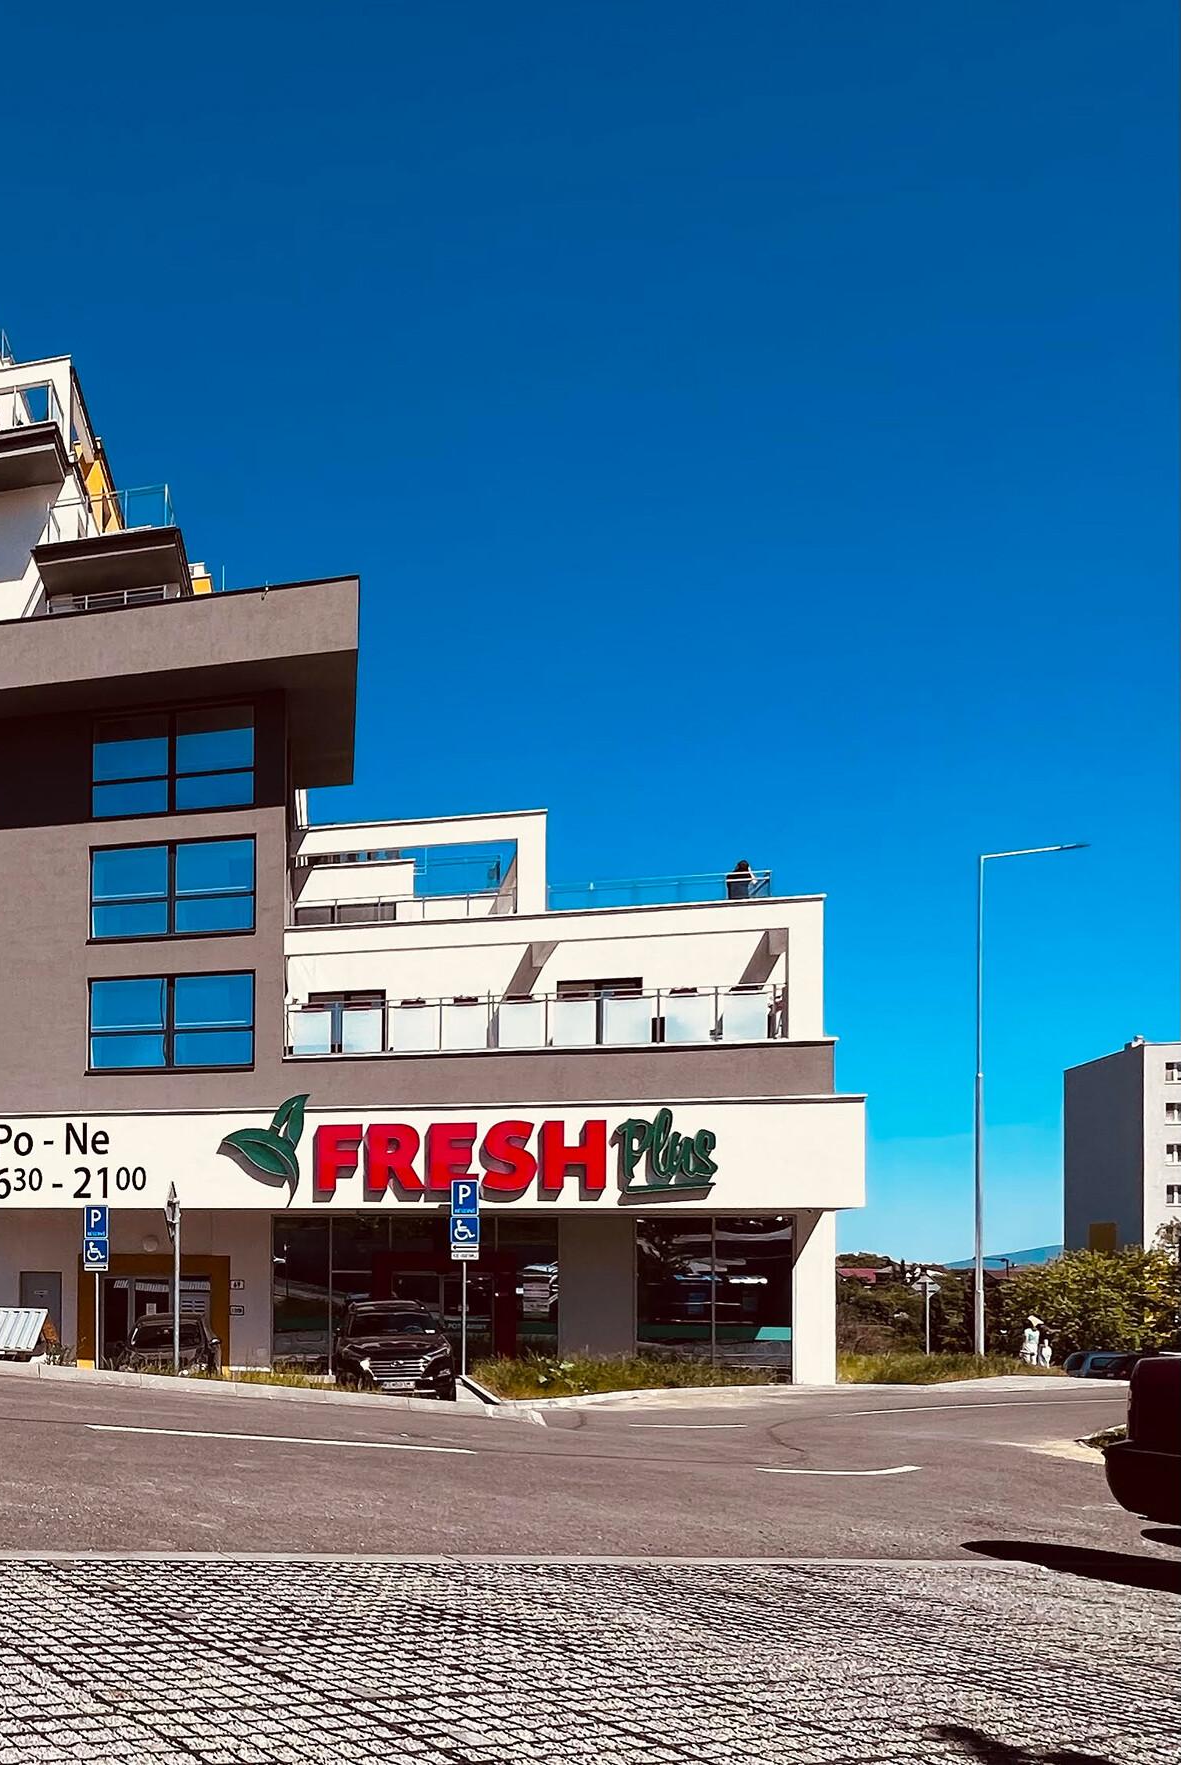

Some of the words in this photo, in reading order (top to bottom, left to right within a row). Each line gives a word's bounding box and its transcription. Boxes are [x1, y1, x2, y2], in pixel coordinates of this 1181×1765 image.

[65, 1122, 110, 1155] Ne
[313, 1119, 607, 1202] FRESH
[609, 1107, 718, 1196] Plus
[458, 1184, 472, 1205] P
[90, 1209, 102, 1228] P
